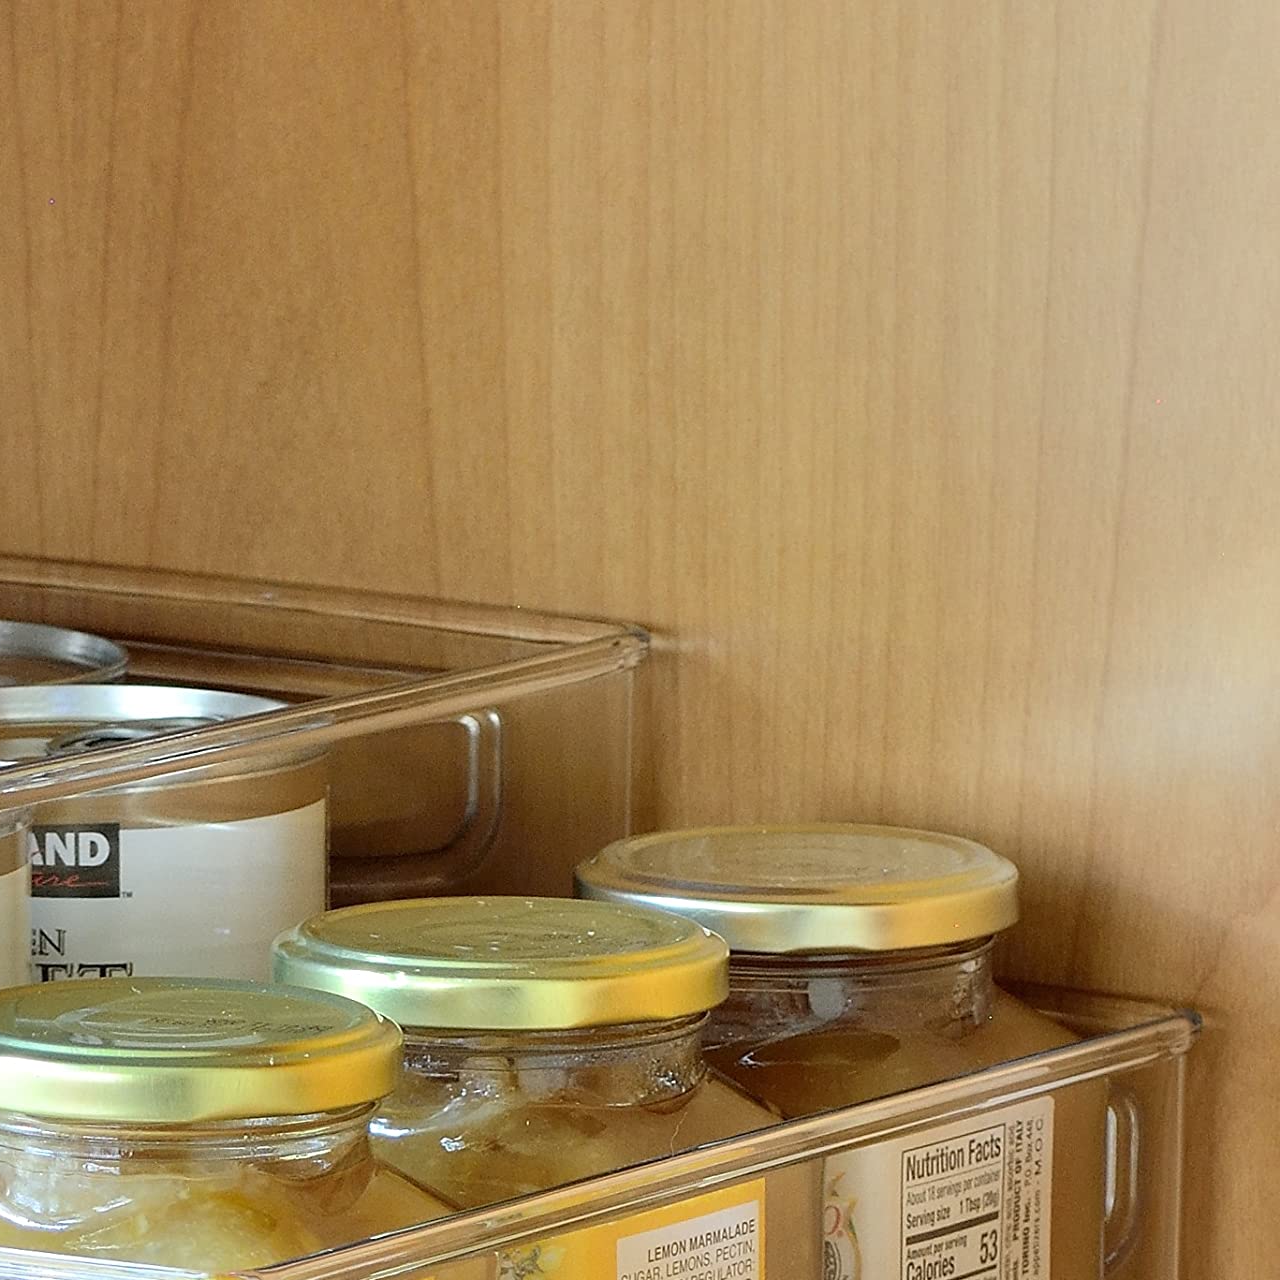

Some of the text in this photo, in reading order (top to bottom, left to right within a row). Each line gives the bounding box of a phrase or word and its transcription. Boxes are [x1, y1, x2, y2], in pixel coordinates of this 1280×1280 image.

[1015, 1120, 1023, 1153] ITALY
[906, 1133, 1002, 1182] Nutrition Facts
[1015, 1158, 1022, 1174] OF
[906, 1208, 935, 1230] Serving
[937, 1205, 951, 1221] size
[1012, 1179, 1022, 1241] PRODUCT
[647, 1218, 755, 1263] LEMON MARMALADE
[666, 1252, 713, 1278] LEMONS,
[716, 1239, 755, 1264] PECTIN,
[980, 1229, 998, 1264] 53
